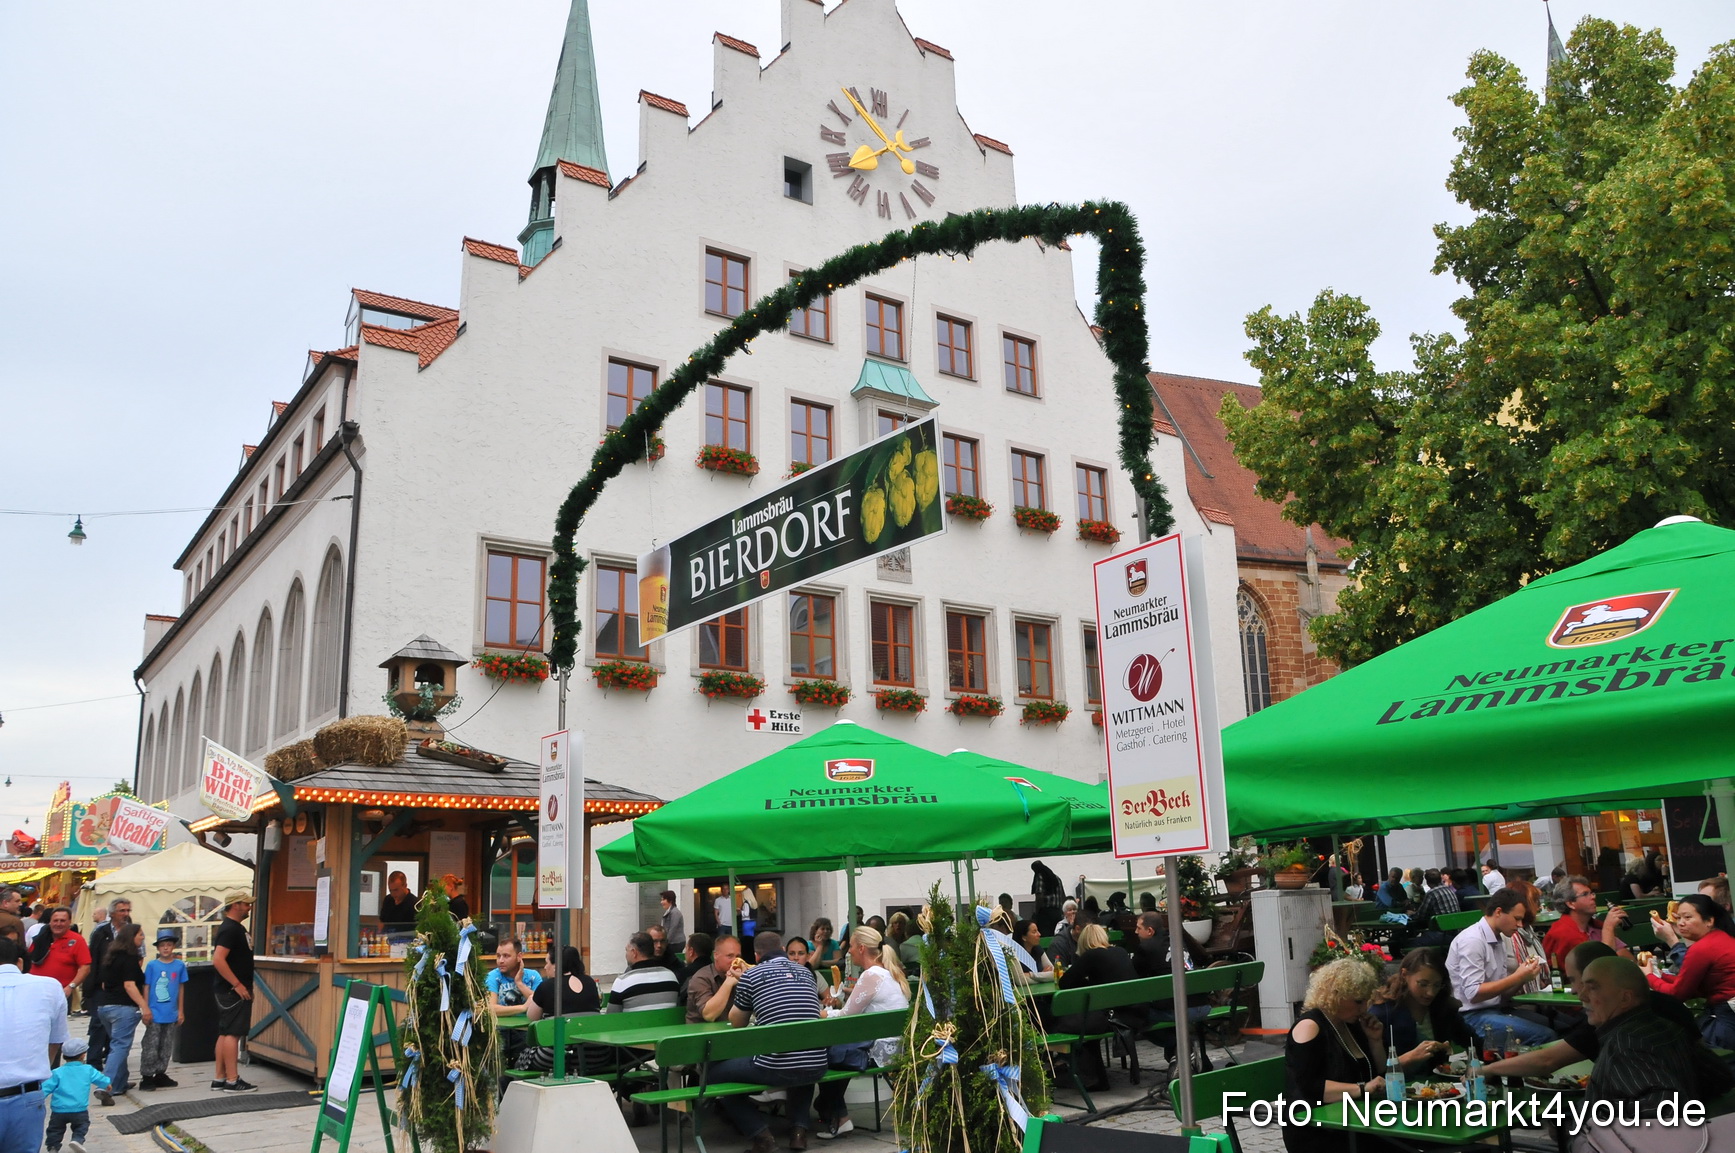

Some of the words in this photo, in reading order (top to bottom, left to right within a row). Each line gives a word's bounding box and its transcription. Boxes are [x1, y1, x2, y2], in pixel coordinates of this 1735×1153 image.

[731, 496, 793, 537] Lammsbräu
[690, 489, 852, 599] BIERDORF
[1113, 596, 1168, 620] Neumarkter
[1105, 607, 1179, 640] Lammsbräu
[1570, 630, 1621, 646] 1628
[1444, 638, 1735, 691] Neumarkter
[1375, 655, 1735, 726] Lammsbrä
[769, 709, 801, 721] Erste
[1112, 698, 1184, 726] WITTMANN
[771, 722, 800, 732] Hilfe
[1115, 723, 1154, 739] Metzgerei
[1162, 715, 1186, 730] Hotel
[1116, 736, 1146, 752] Gasthof
[1152, 731, 1187, 745] Catering
[765, 794, 939, 810] Lammsbräu
[789, 785, 915, 797] Neumarkter
[123, 806, 165, 827] Saftige
[1124, 820, 1153, 830] Natürlich
[1166, 815, 1192, 825] Franken
[110, 814, 160, 849] Steaks
